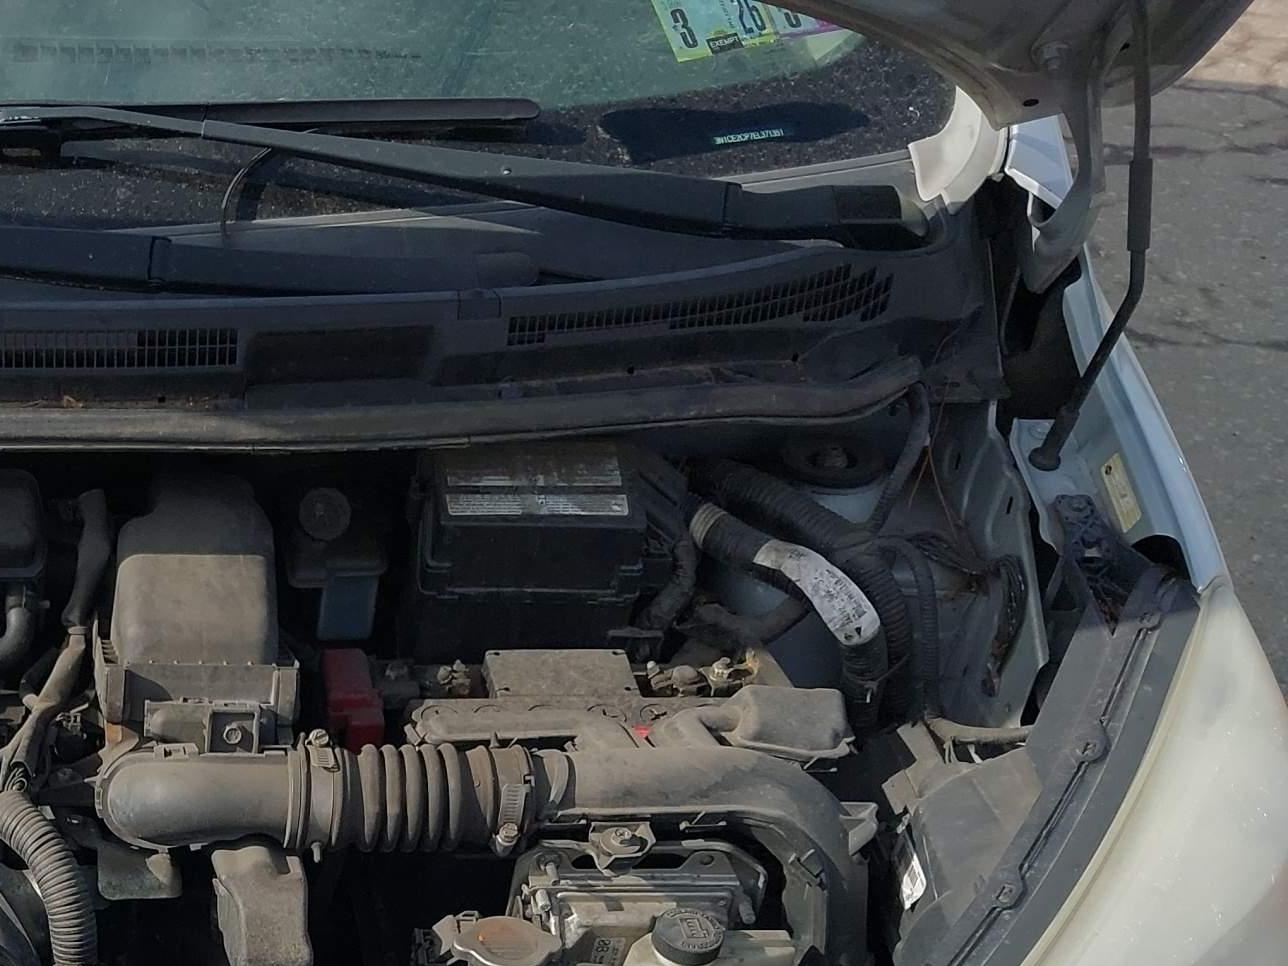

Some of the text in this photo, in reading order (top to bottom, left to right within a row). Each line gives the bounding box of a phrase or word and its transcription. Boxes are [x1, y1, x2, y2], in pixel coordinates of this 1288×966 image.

[670, 8, 698, 48] 3
[731, 0, 766, 34] 26
[709, 36, 740, 50] EXEMPT
